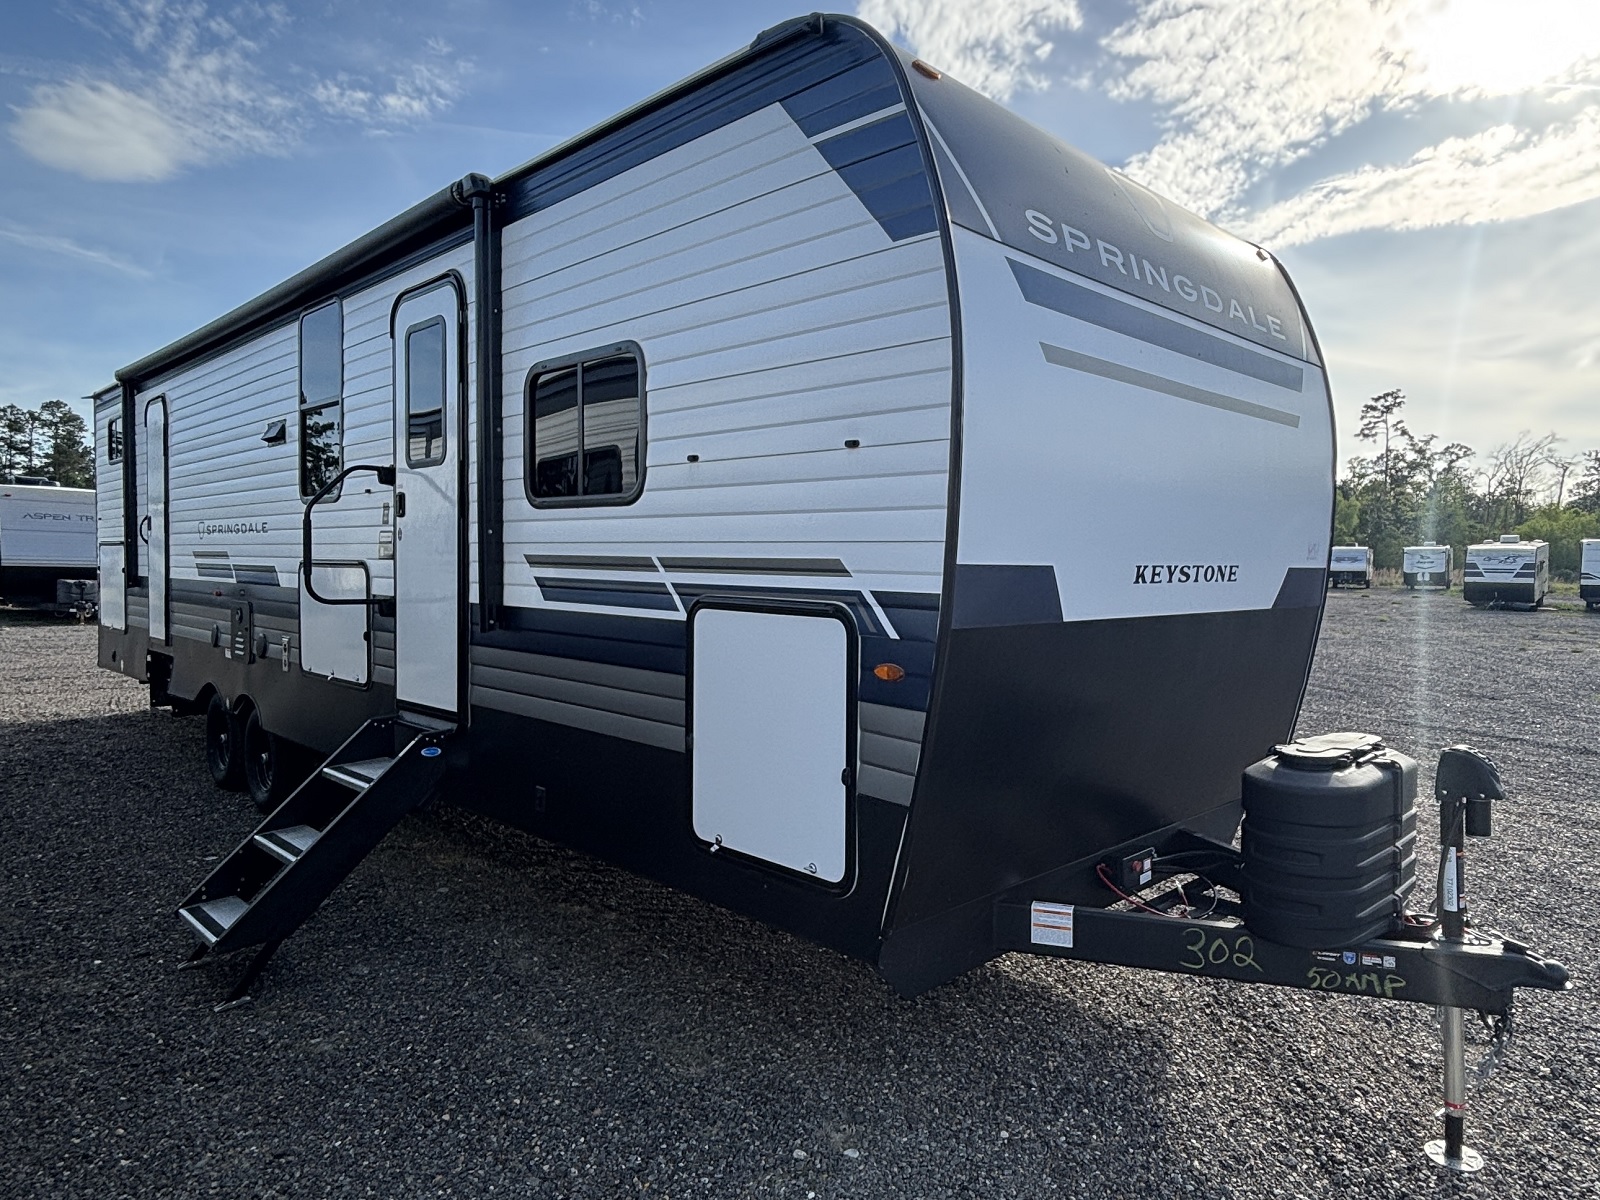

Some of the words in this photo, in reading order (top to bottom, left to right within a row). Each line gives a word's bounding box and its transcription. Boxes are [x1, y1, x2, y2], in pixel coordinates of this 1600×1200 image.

[1025, 209, 1286, 341] SPRINGDALE
[23, 512, 71, 521] ASPEN
[206, 522, 268, 535] SPRINGDALE
[1133, 565, 1239, 584] KEYSTONE
[1179, 927, 1263, 973] 302
[1307, 967, 1341, 989] 50
[1345, 972, 1406, 998] AMP
